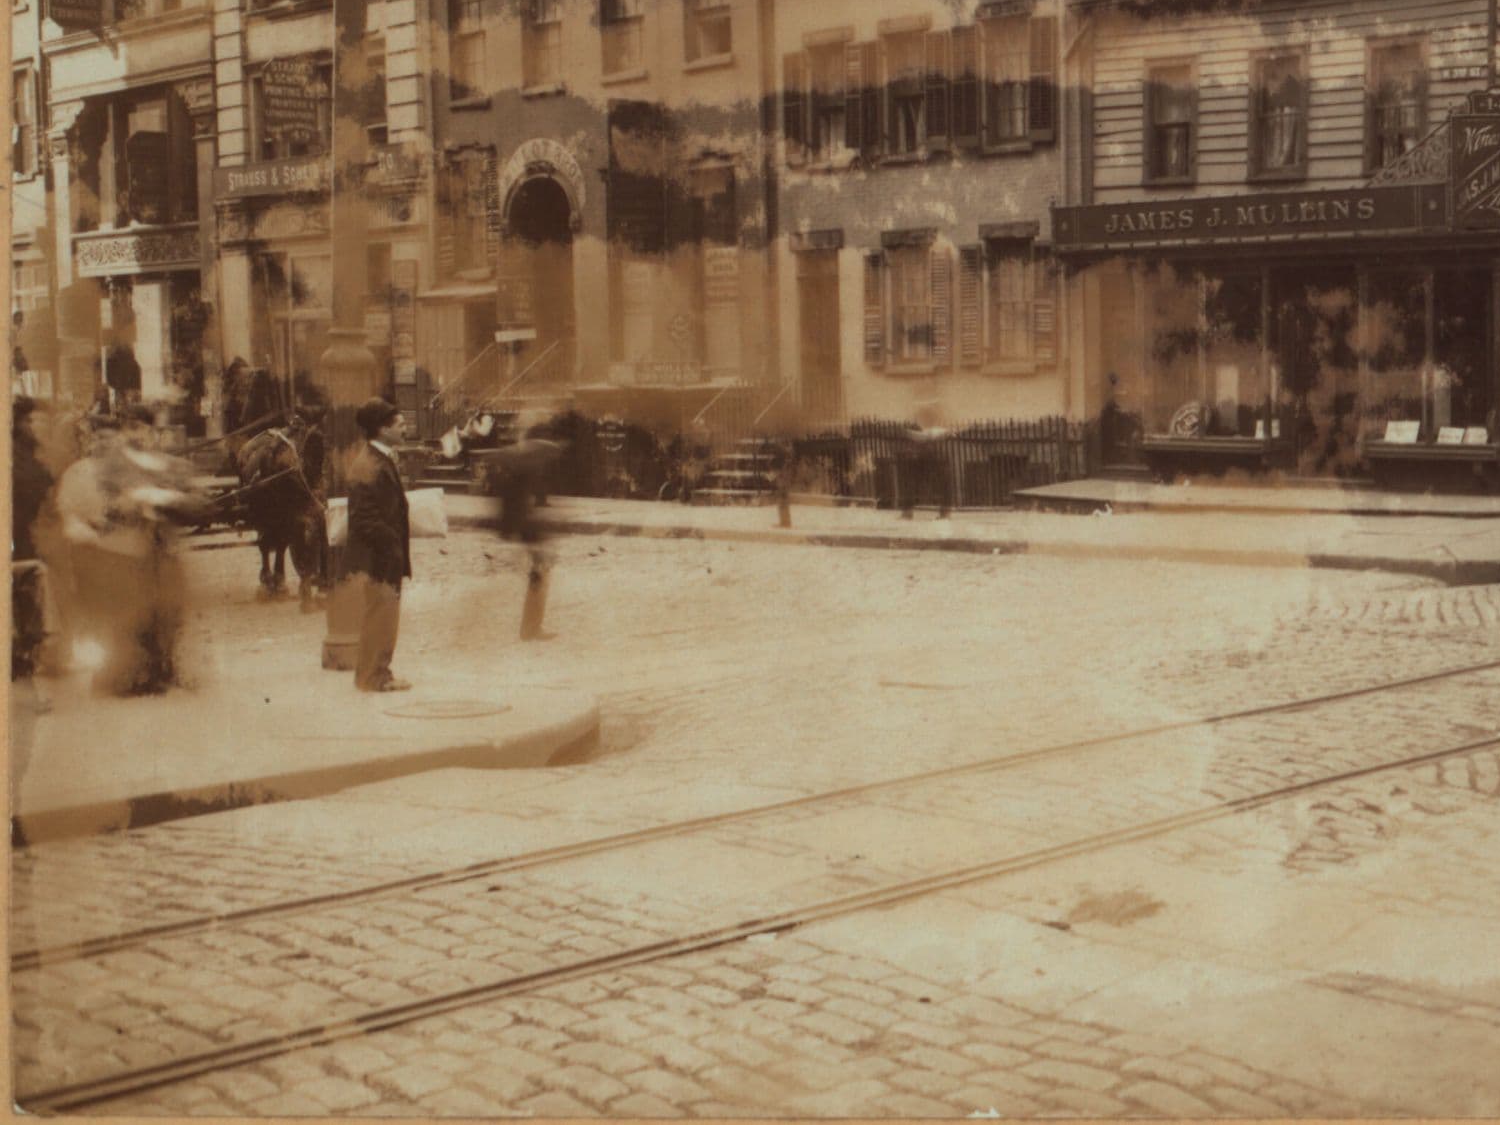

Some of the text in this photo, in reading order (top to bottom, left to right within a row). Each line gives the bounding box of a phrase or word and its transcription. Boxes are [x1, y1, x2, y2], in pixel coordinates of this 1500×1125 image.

[228, 170, 268, 192] STRAUSS
[271, 164, 280, 186] &
[1104, 196, 1377, 235] JAMES J. MULLINS
